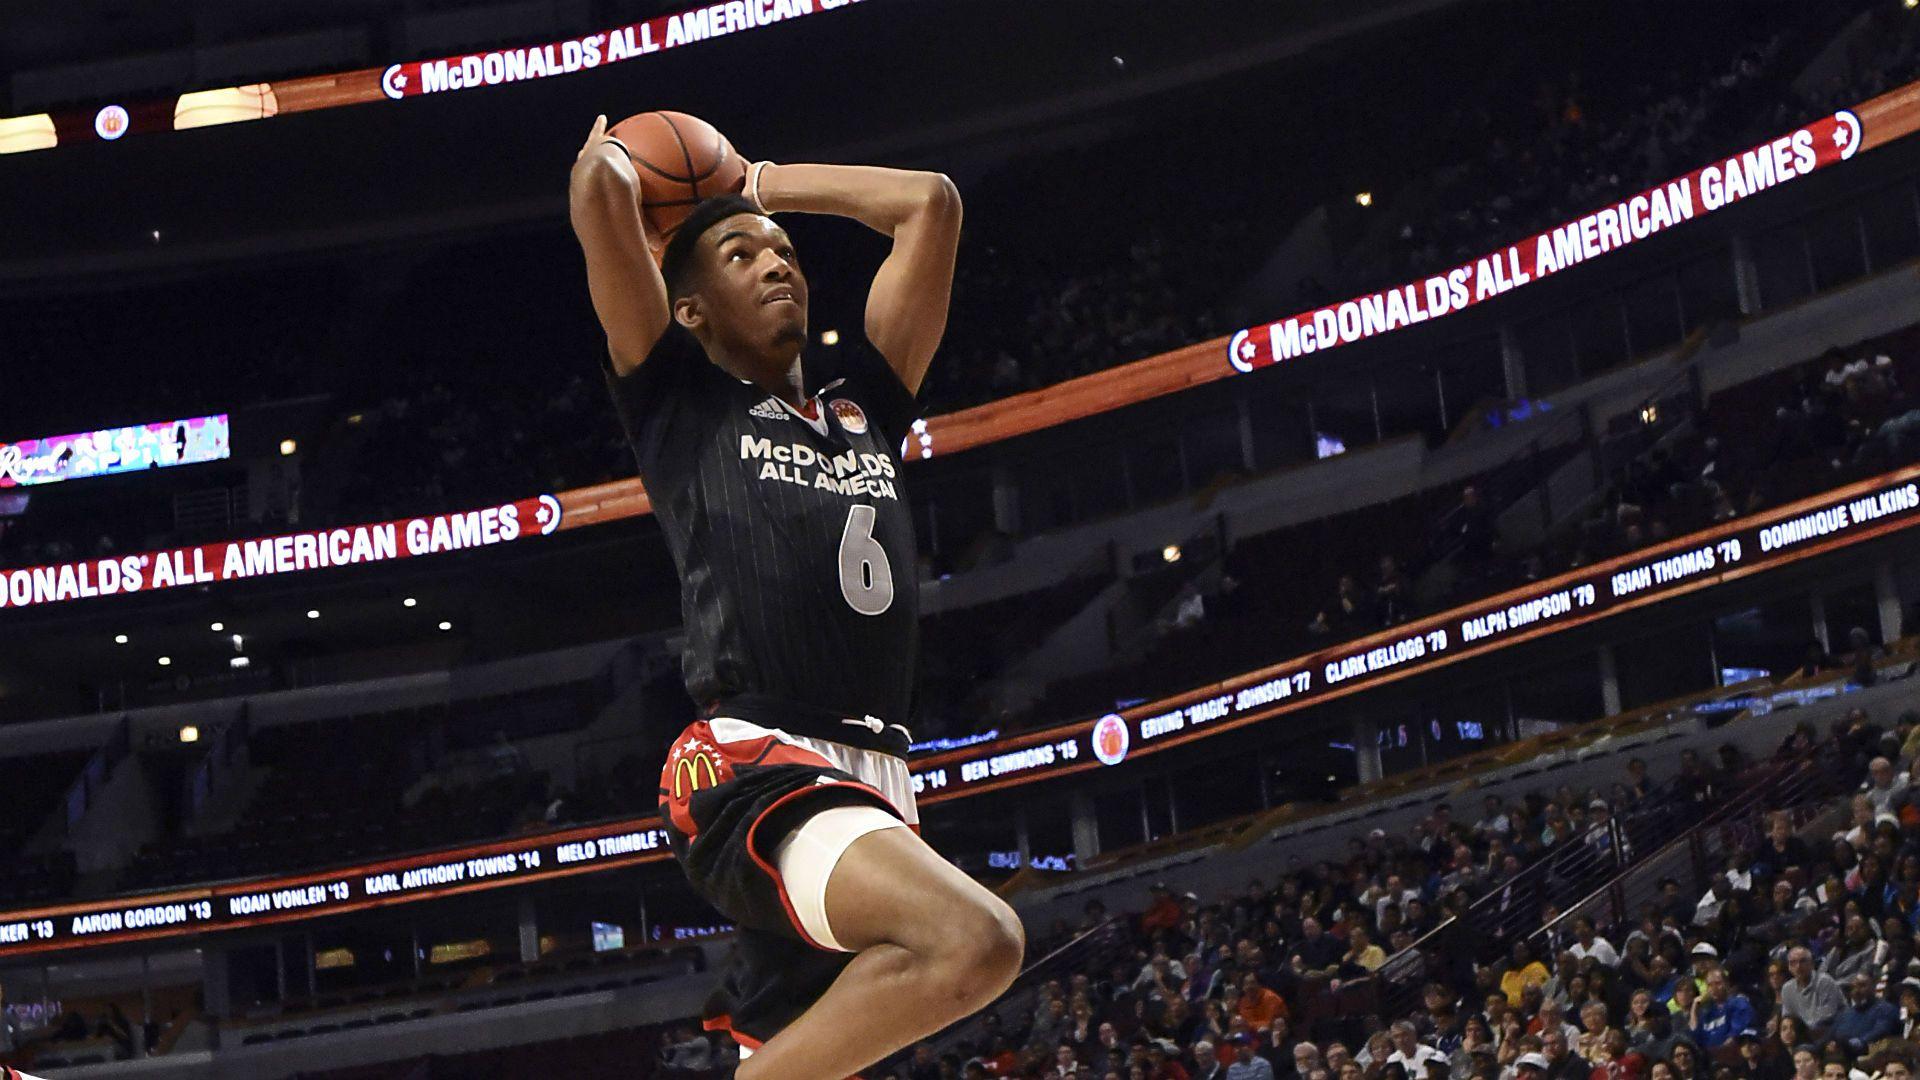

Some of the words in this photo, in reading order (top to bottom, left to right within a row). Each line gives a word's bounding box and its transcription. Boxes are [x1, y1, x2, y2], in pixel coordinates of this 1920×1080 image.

[607, 23, 660, 62] ALL
[1476, 246, 1530, 301] ALL
[1535, 177, 1694, 278] AMERICAN
[1699, 129, 1817, 211] GAMES
[748, 408, 790, 421] adidas
[759, 461, 809, 487] ALL
[1759, 505, 1849, 552] DOMINIQUE
[1849, 483, 1920, 524] WILKINS
[152, 548, 214, 588] ALL
[222, 523, 397, 580] AMERICAN
[406, 503, 520, 555] GAMES
[838, 504, 894, 615] 6
[1612, 565, 1652, 596] ISIAH
[1652, 547, 1716, 584] THOMAS
[1461, 610, 1507, 642] RALPH
[1507, 590, 1572, 629] SIMPSON
[1325, 653, 1367, 684] CLARK
[1367, 636, 1426, 671] KELLOGG
[1235, 677, 1292, 711] JOHNSON
[960, 759, 990, 783] BEN
[990, 745, 1055, 776] SIMMONS
[556, 840, 597, 864] MELO
[598, 829, 659, 858] TRIMBLE
[364, 874, 401, 895] KARL
[402, 862, 465, 889] ANTHONY
[466, 852, 518, 878] TOWNS
[72, 911, 122, 935] AARON
[124, 904, 187, 929] GORDON
[229, 893, 271, 916] NOAH
[272, 885, 327, 910] VONLEH
